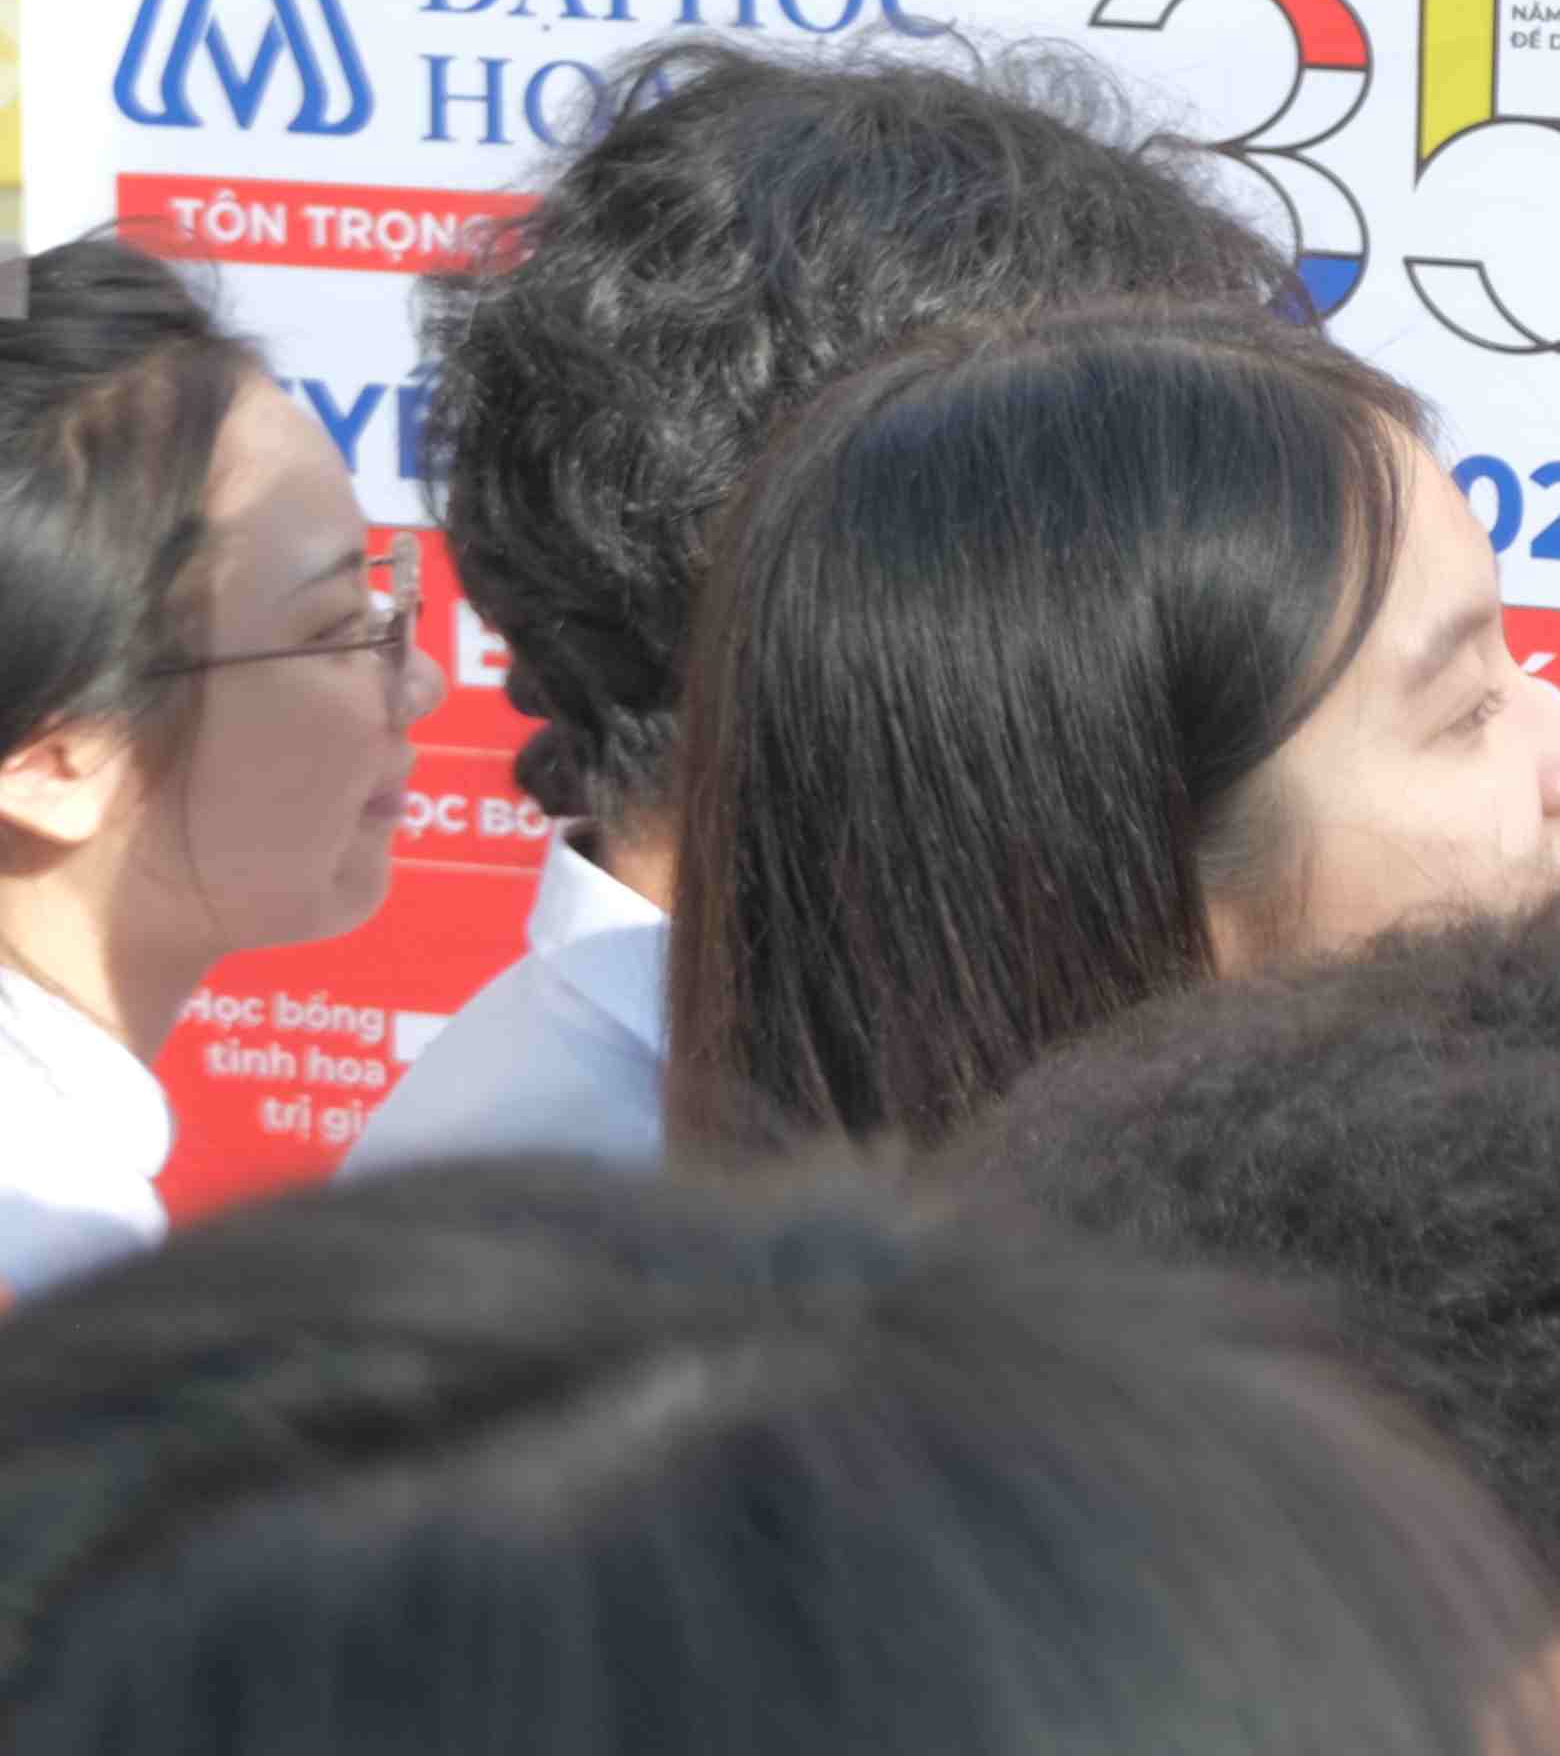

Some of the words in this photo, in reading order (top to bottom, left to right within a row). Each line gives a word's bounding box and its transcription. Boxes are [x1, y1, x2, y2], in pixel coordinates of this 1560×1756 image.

[168, 188, 288, 245] TÔN
[304, 1044, 387, 1087] hoa
[261, 1094, 313, 1140] trị
[320, 1098, 368, 1149] gi
